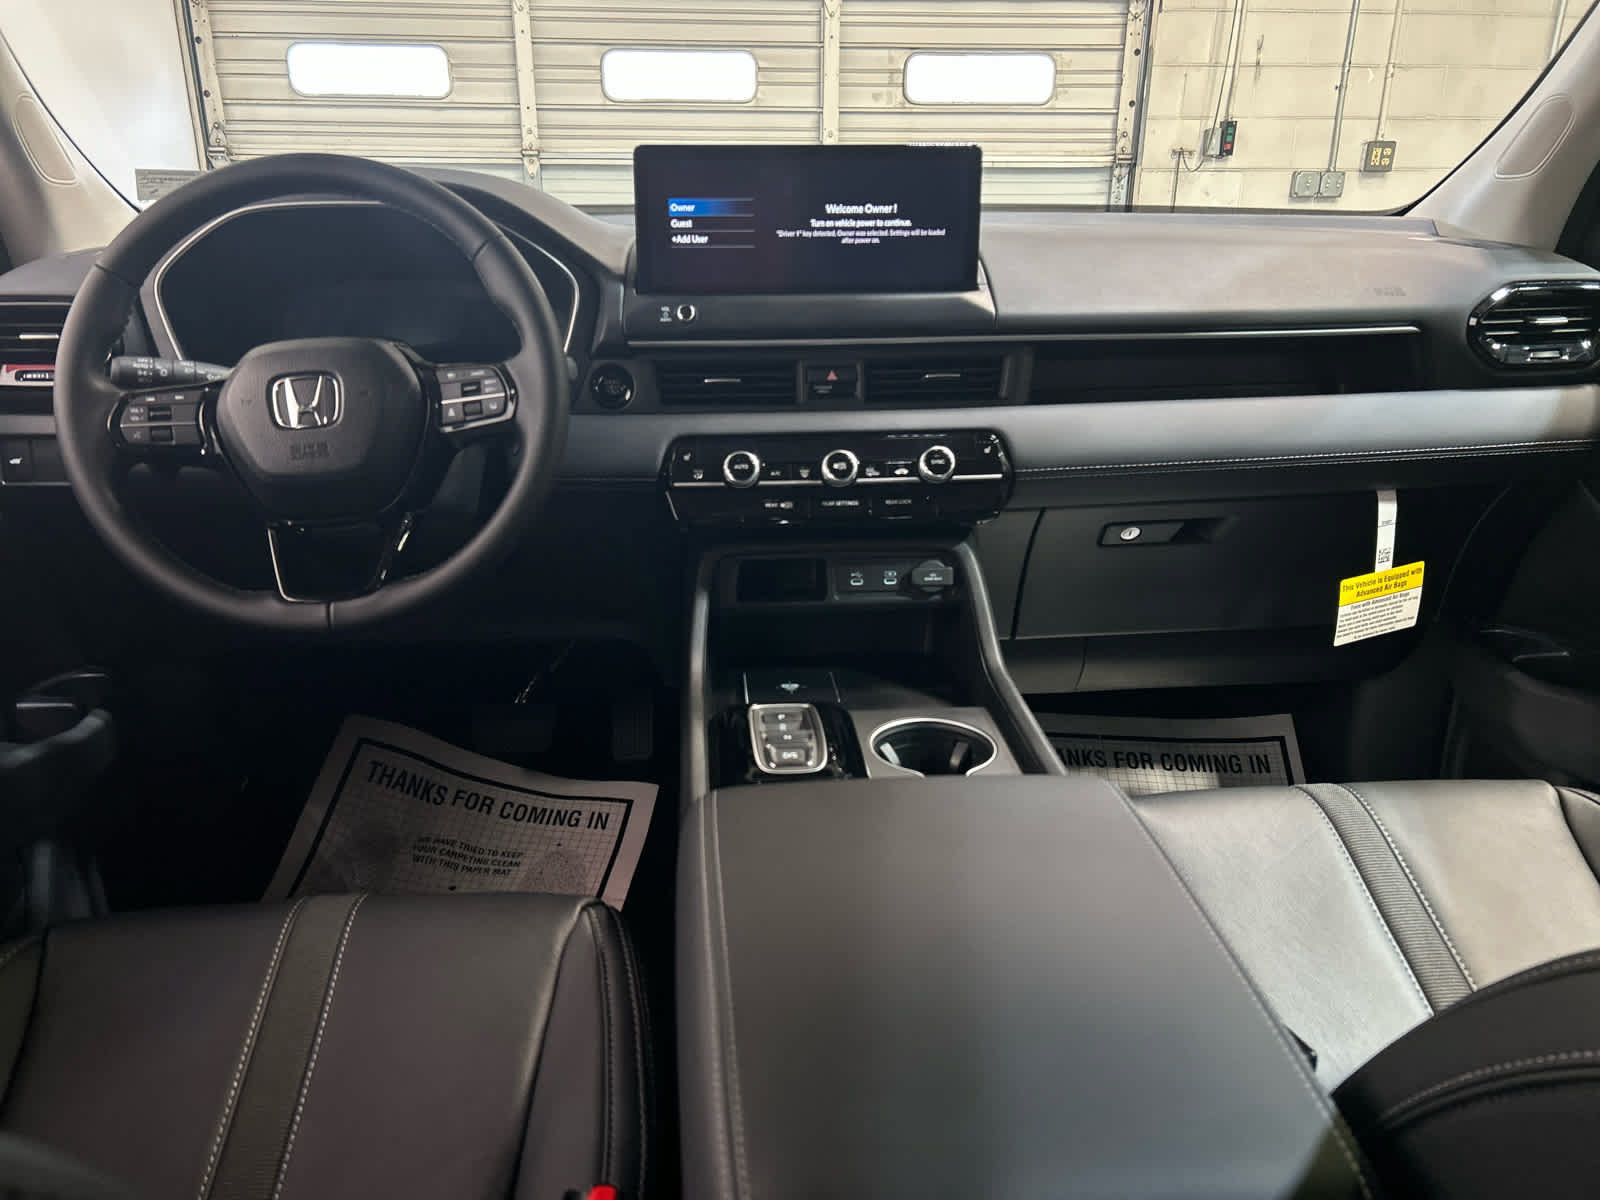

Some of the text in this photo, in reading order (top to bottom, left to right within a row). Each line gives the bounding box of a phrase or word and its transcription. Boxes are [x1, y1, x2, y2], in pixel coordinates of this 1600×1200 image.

[670, 203, 696, 213] Owner
[825, 203, 864, 214] Welcome
[865, 203, 893, 214] Owner
[670, 219, 693, 229] Guest
[810, 219, 825, 228] Turn
[835, 219, 855, 227] vehicle
[856, 221, 875, 229] power
[876, 219, 884, 227] to
[890, 229, 910, 238] Settings
[692, 234, 709, 244] User
[1342, 584, 1354, 592] This
[1355, 579, 1376, 590] Vehicle
[1384, 569, 1410, 584] Equipped
[1411, 567, 1423, 576] with
[1356, 579, 1408, 598] Advanced Air Bags
[1056, 748, 1271, 774] ANKS FOR COMING IN
[367, 760, 610, 830] THANKS FOR COMING IN
[413, 845, 520, 868] YOUR CARPETING CLEAN
[433, 838, 457, 848] HAVE
[458, 842, 486, 856] TRIED
[487, 849, 498, 857] TO
[412, 854, 512, 876] WITH THIS PAPER MAT
